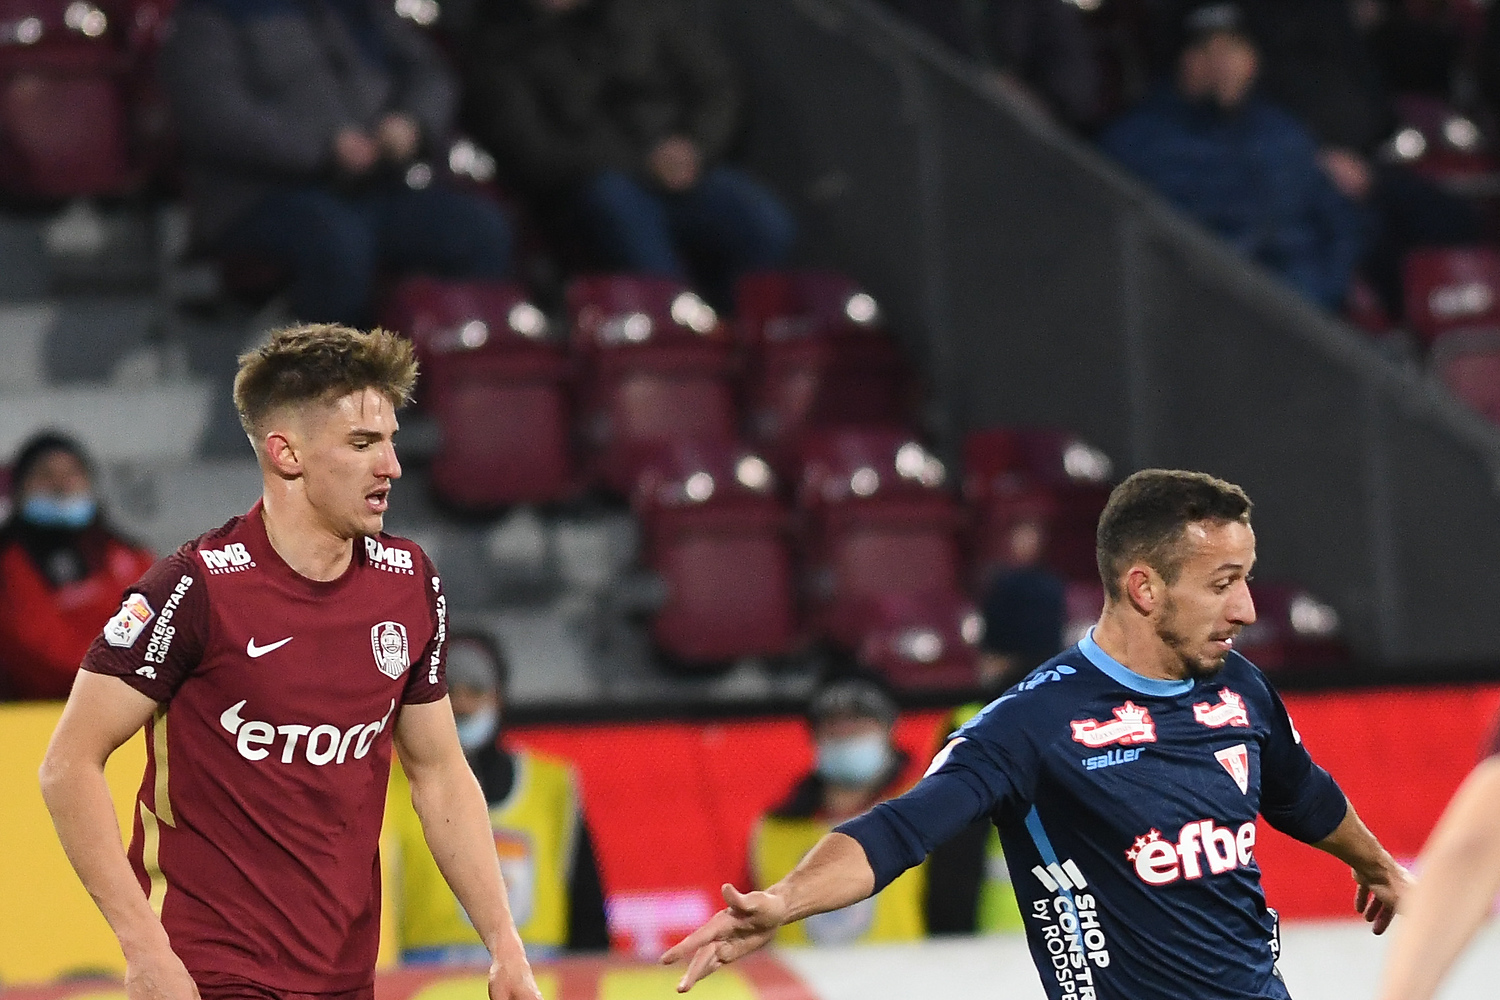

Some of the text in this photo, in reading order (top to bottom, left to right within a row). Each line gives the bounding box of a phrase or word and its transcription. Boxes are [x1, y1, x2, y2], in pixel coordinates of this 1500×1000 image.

[199, 543, 252, 569] RMB
[364, 536, 413, 569] RMB
[144, 575, 194, 663] POKERSTARS
[155, 626, 176, 664] CASINO
[1032, 898, 1051, 922] by
[1074, 893, 1111, 969] SHOP
